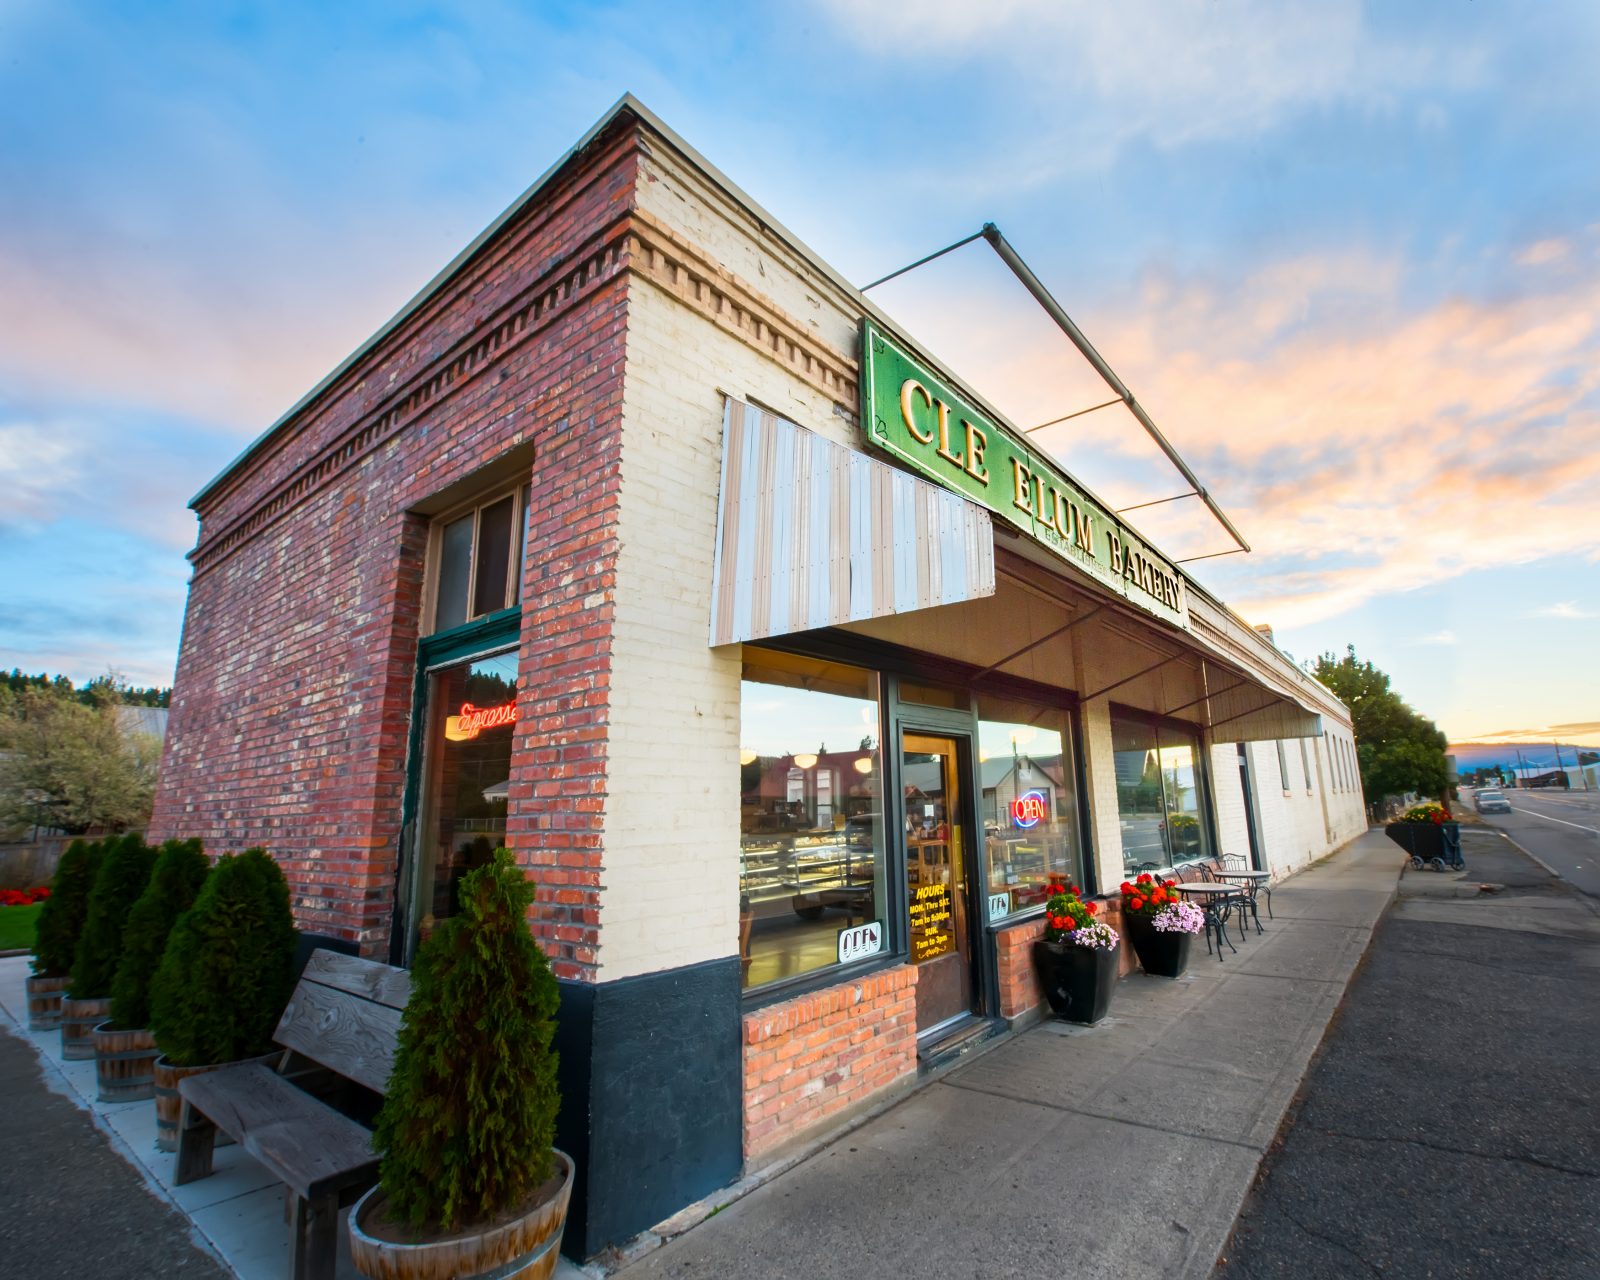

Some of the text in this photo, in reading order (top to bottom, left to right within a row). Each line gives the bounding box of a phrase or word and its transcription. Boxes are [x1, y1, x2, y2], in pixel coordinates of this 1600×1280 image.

[900, 379, 1183, 614] CLE ELUM BAKERY
[1015, 799, 1045, 819] OPEN
[916, 884, 945, 899] HOURS
[909, 898, 950, 914] MON. Thru SAT.
[911, 919, 924, 927] 7am
[924, 916, 930, 924] to
[925, 926, 938, 936] SUN.
[843, 926, 878, 958] OPEN
[916, 935, 947, 950] 7am to 3pm
